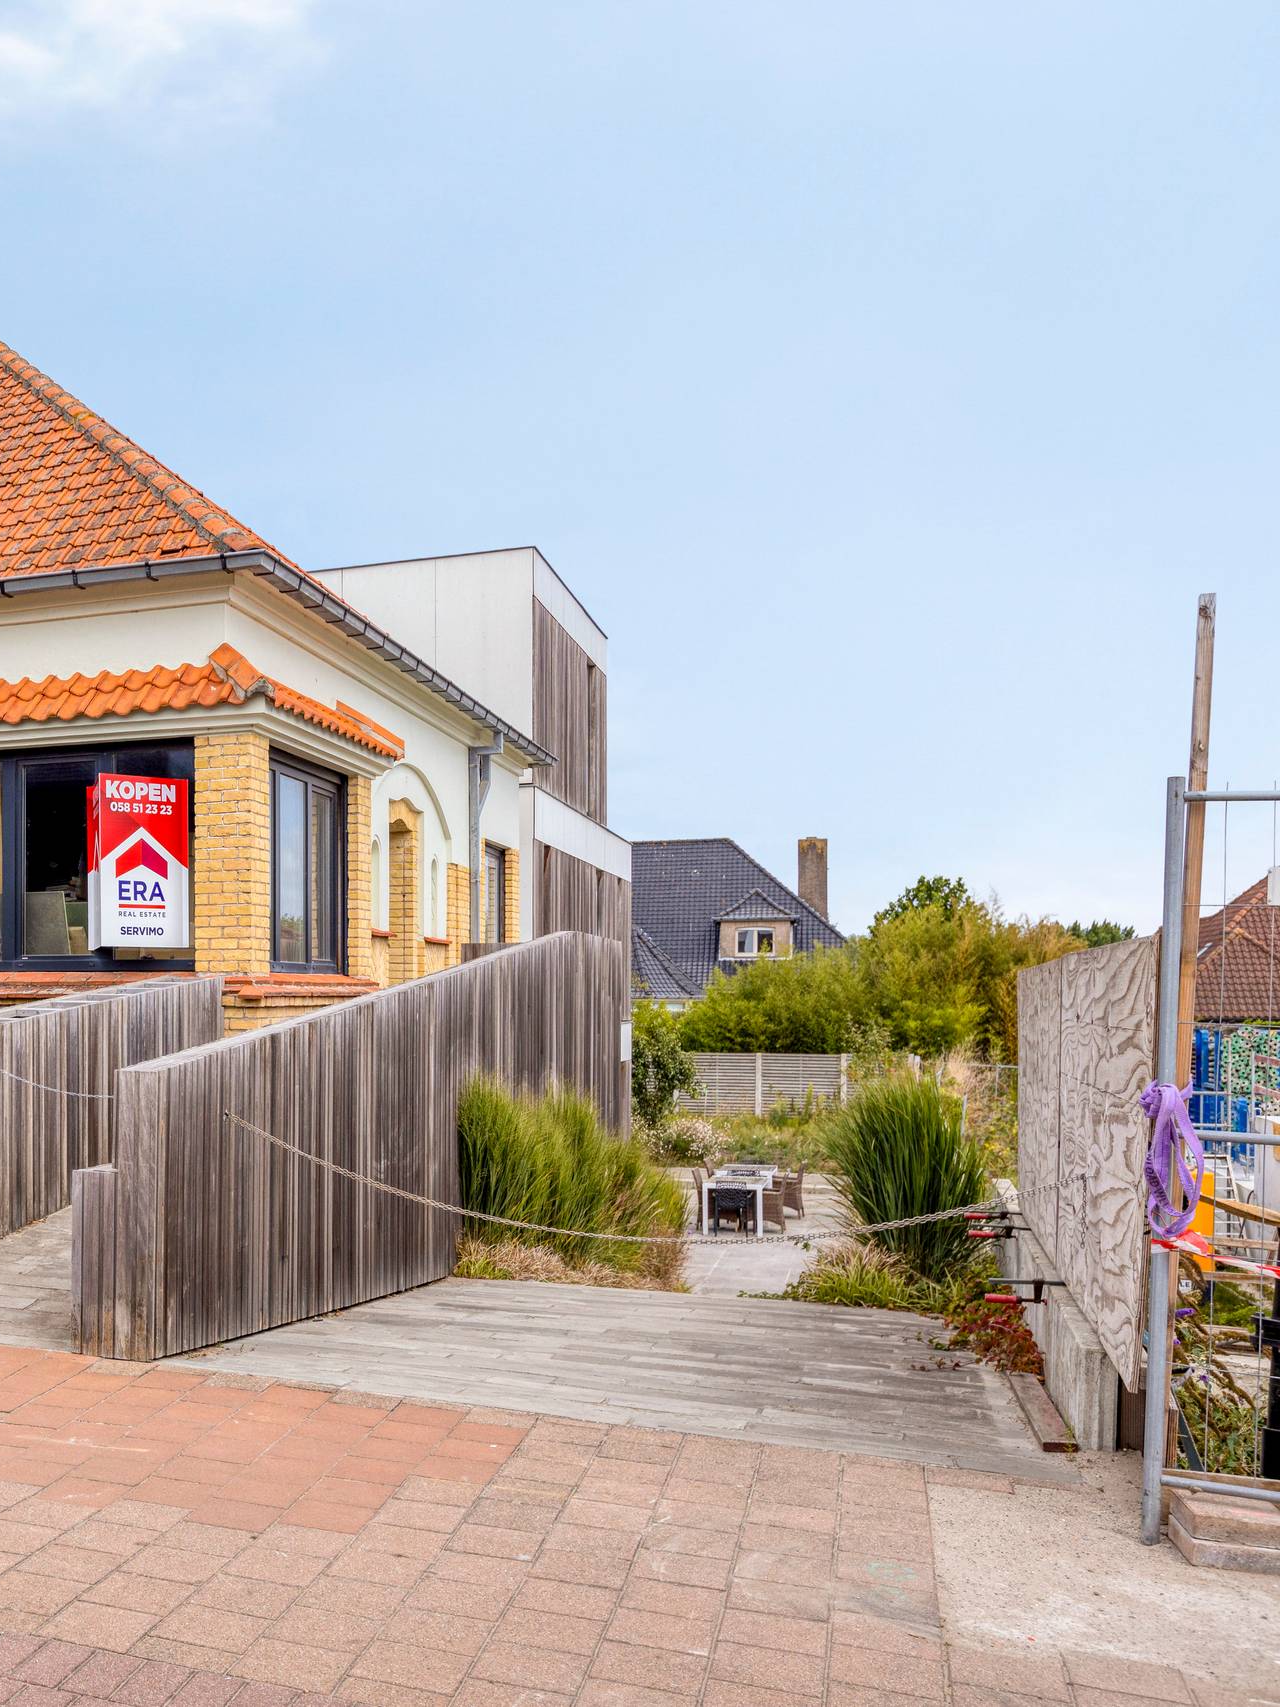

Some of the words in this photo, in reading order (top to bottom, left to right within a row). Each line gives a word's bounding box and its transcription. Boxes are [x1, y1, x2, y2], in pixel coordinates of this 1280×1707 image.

[105, 780, 176, 802] KOPEN
[110, 801, 130, 813] 058
[132, 803, 143, 813] 51
[145, 804, 158, 814] 23
[160, 805, 173, 815] 23
[118, 880, 165, 902] ERA
[118, 910, 136, 918] REAL
[120, 926, 164, 936] SERVIMO
